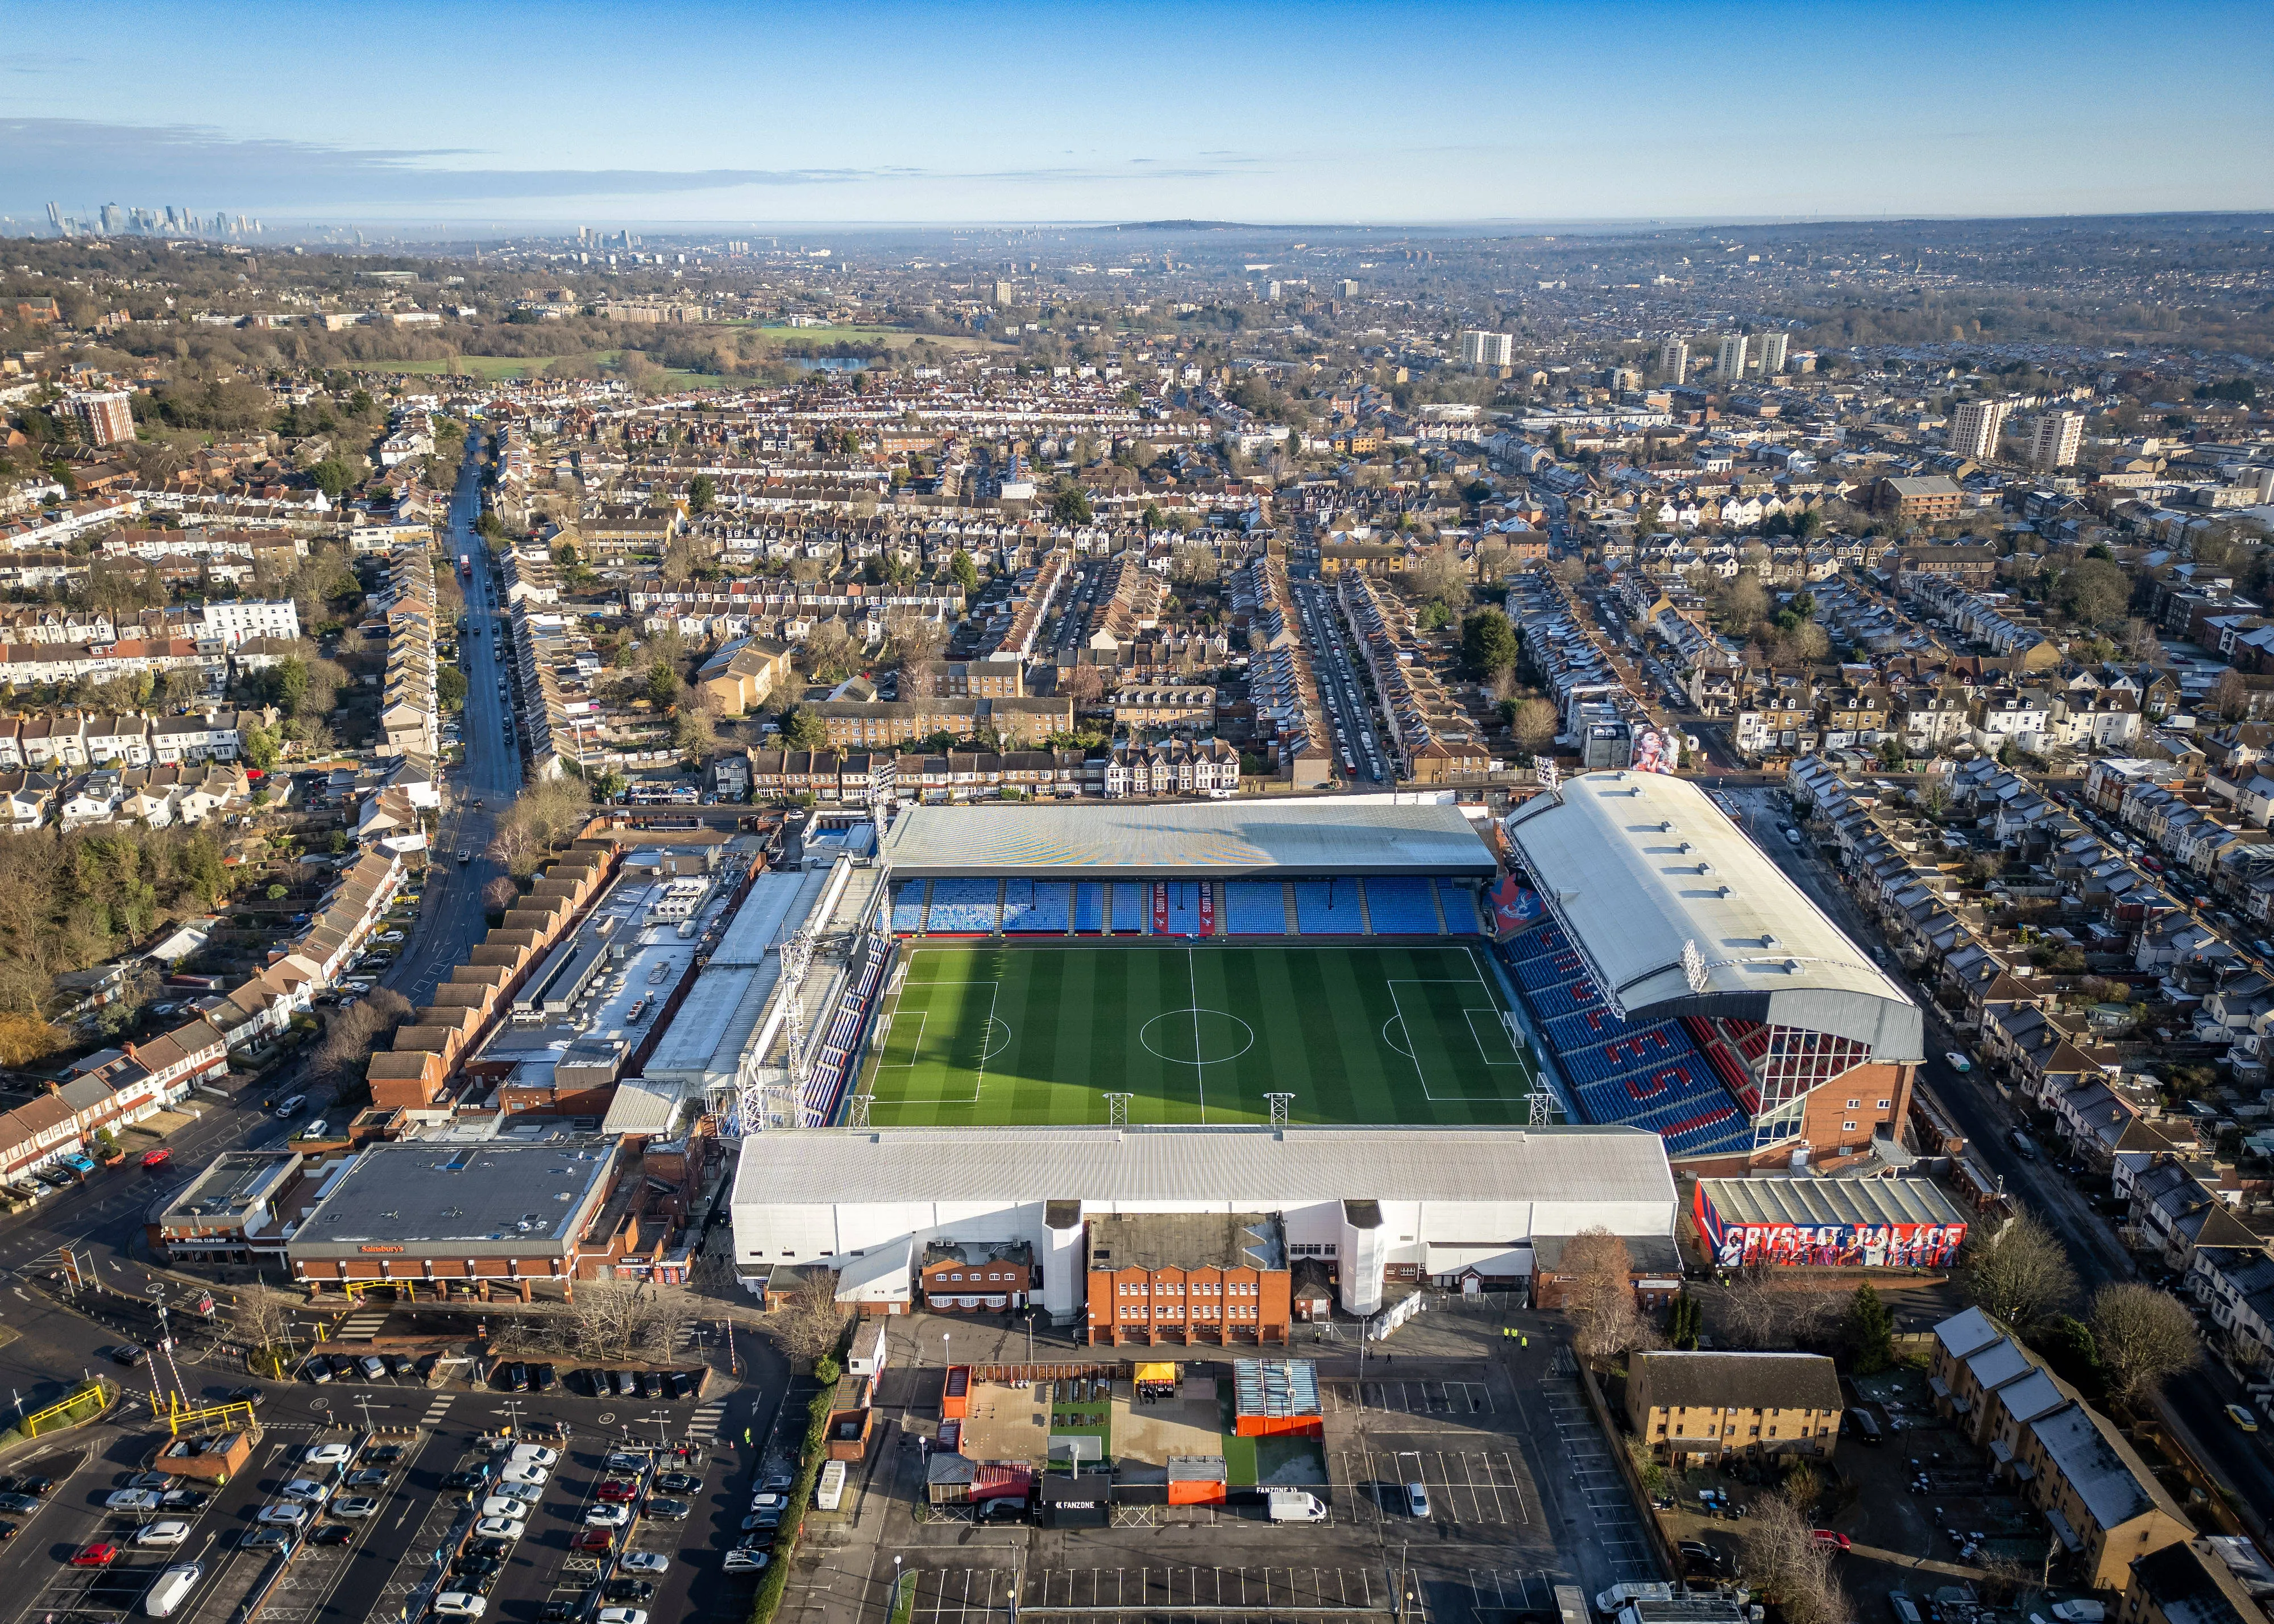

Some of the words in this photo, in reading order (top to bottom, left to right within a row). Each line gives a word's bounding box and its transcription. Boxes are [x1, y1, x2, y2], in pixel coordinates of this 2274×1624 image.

[1156, 882, 1165, 896] LOND
[1156, 898, 1165, 912] SOUTH
[1202, 898, 1211, 912] SOUTH
[171, 1286, 206, 1307] TRAFFIC
[716, 1322, 727, 1336] ENTRY
